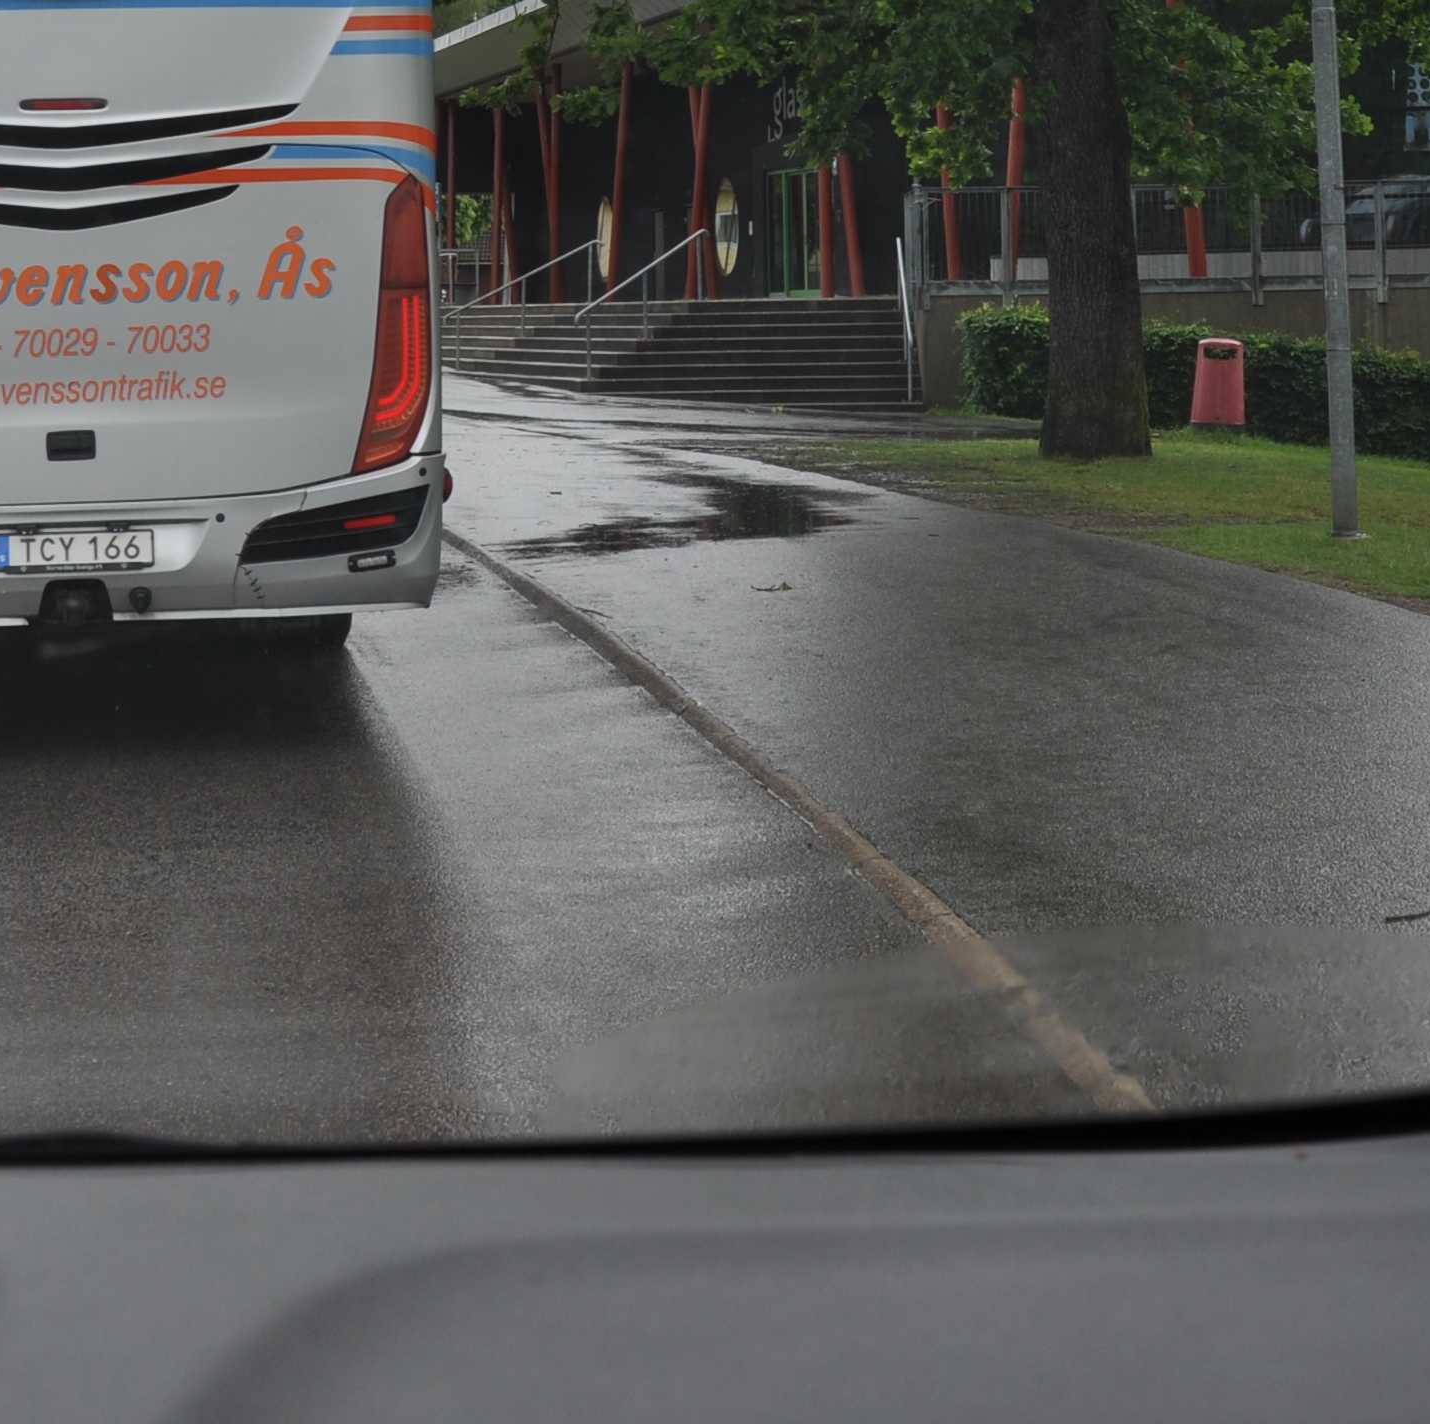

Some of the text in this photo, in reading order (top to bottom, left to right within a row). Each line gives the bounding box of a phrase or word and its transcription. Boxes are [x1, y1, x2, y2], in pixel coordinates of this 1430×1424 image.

[257, 225, 336, 298] Ås
[13, 326, 99, 358] 70029
[127, 322, 211, 355] 70033
[20, 535, 140, 562] TCY 166
